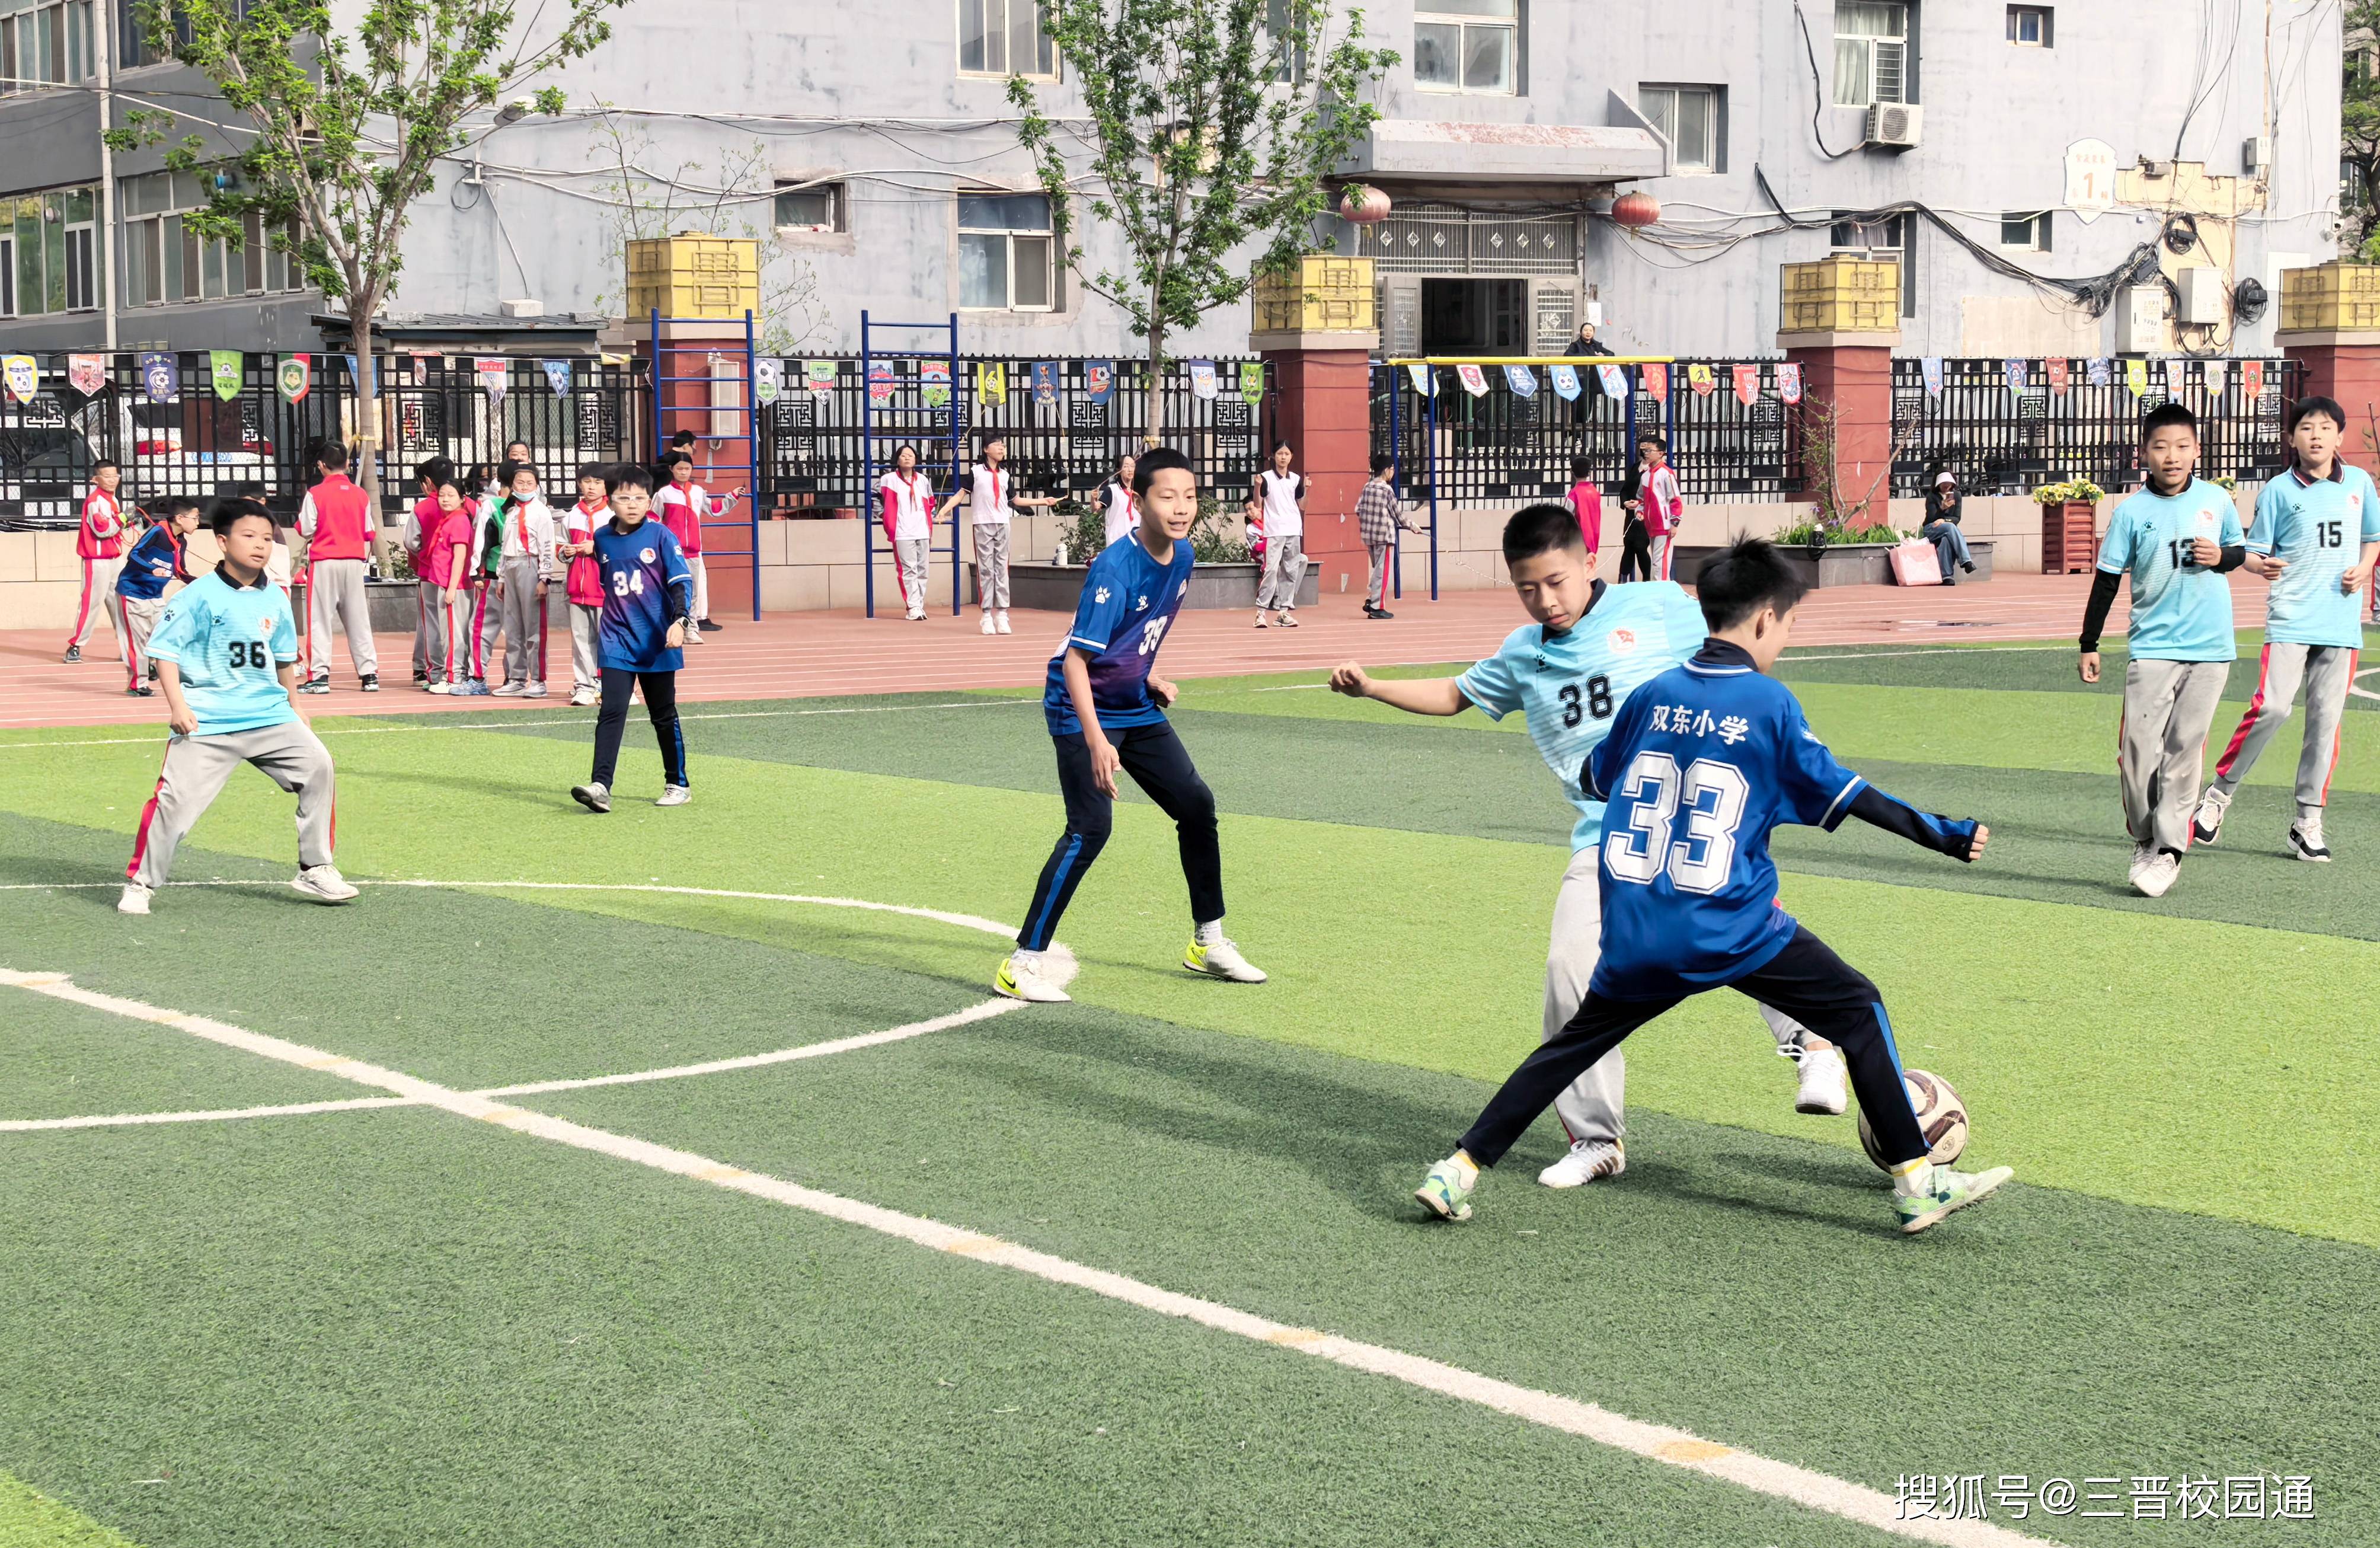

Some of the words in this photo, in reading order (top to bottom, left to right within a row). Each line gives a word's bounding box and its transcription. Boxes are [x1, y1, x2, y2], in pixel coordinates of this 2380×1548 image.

[2084, 172, 2094, 200] 1
[2317, 521, 2343, 548] 15
[613, 569, 644, 596] 34
[1138, 615, 1168, 656] 39
[228, 641, 266, 669] 36
[1558, 674, 1615, 729] 38
[1649, 704, 1749, 745] 双东小学
[1603, 750, 1750, 895] 33
